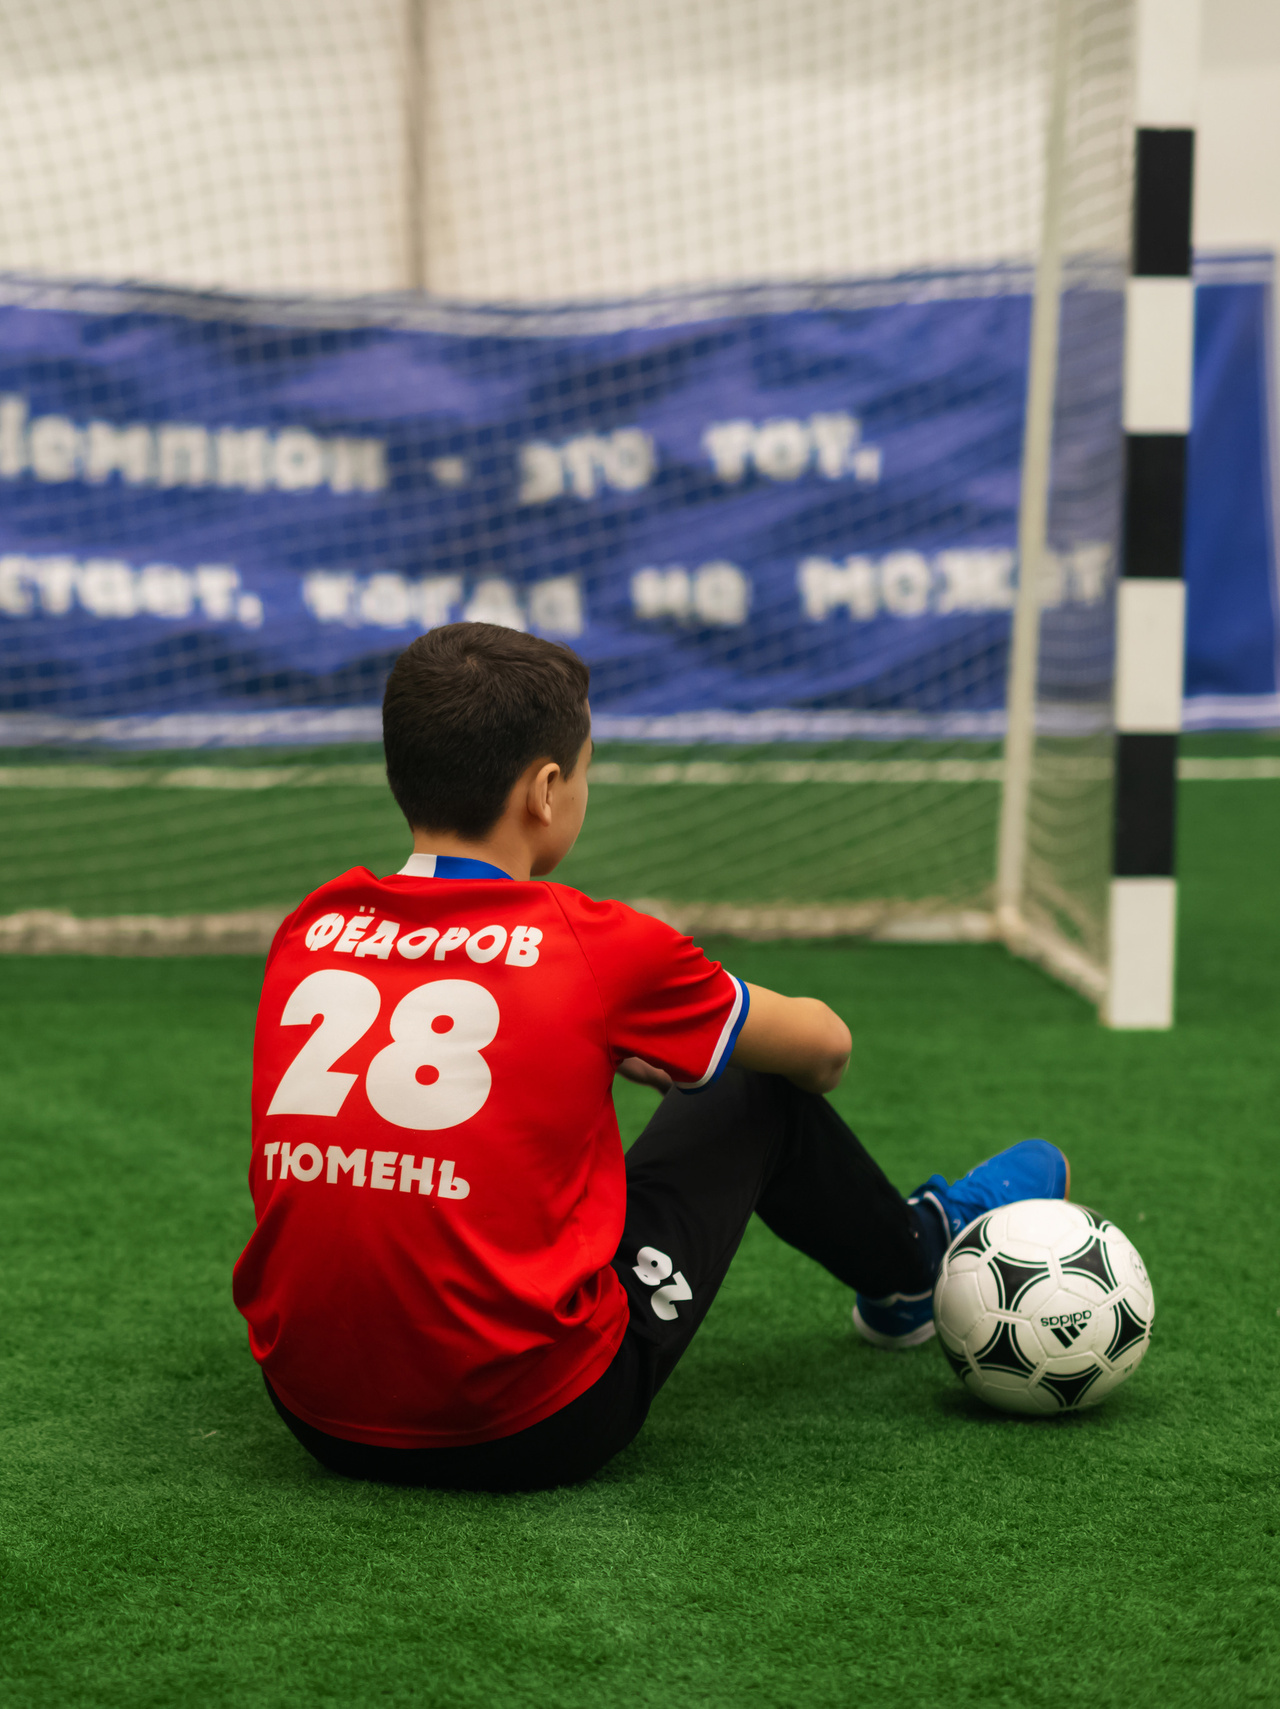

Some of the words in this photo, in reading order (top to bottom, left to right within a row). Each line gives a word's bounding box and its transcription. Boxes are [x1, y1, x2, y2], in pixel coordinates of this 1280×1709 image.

[522, 426, 655, 504] это
[305, 906, 543, 967] ФЁДОРОВ
[266, 969, 500, 1131] 28
[264, 1141, 470, 1200] ТЮМЕНЬ
[1040, 1309, 1092, 1327] adidas
